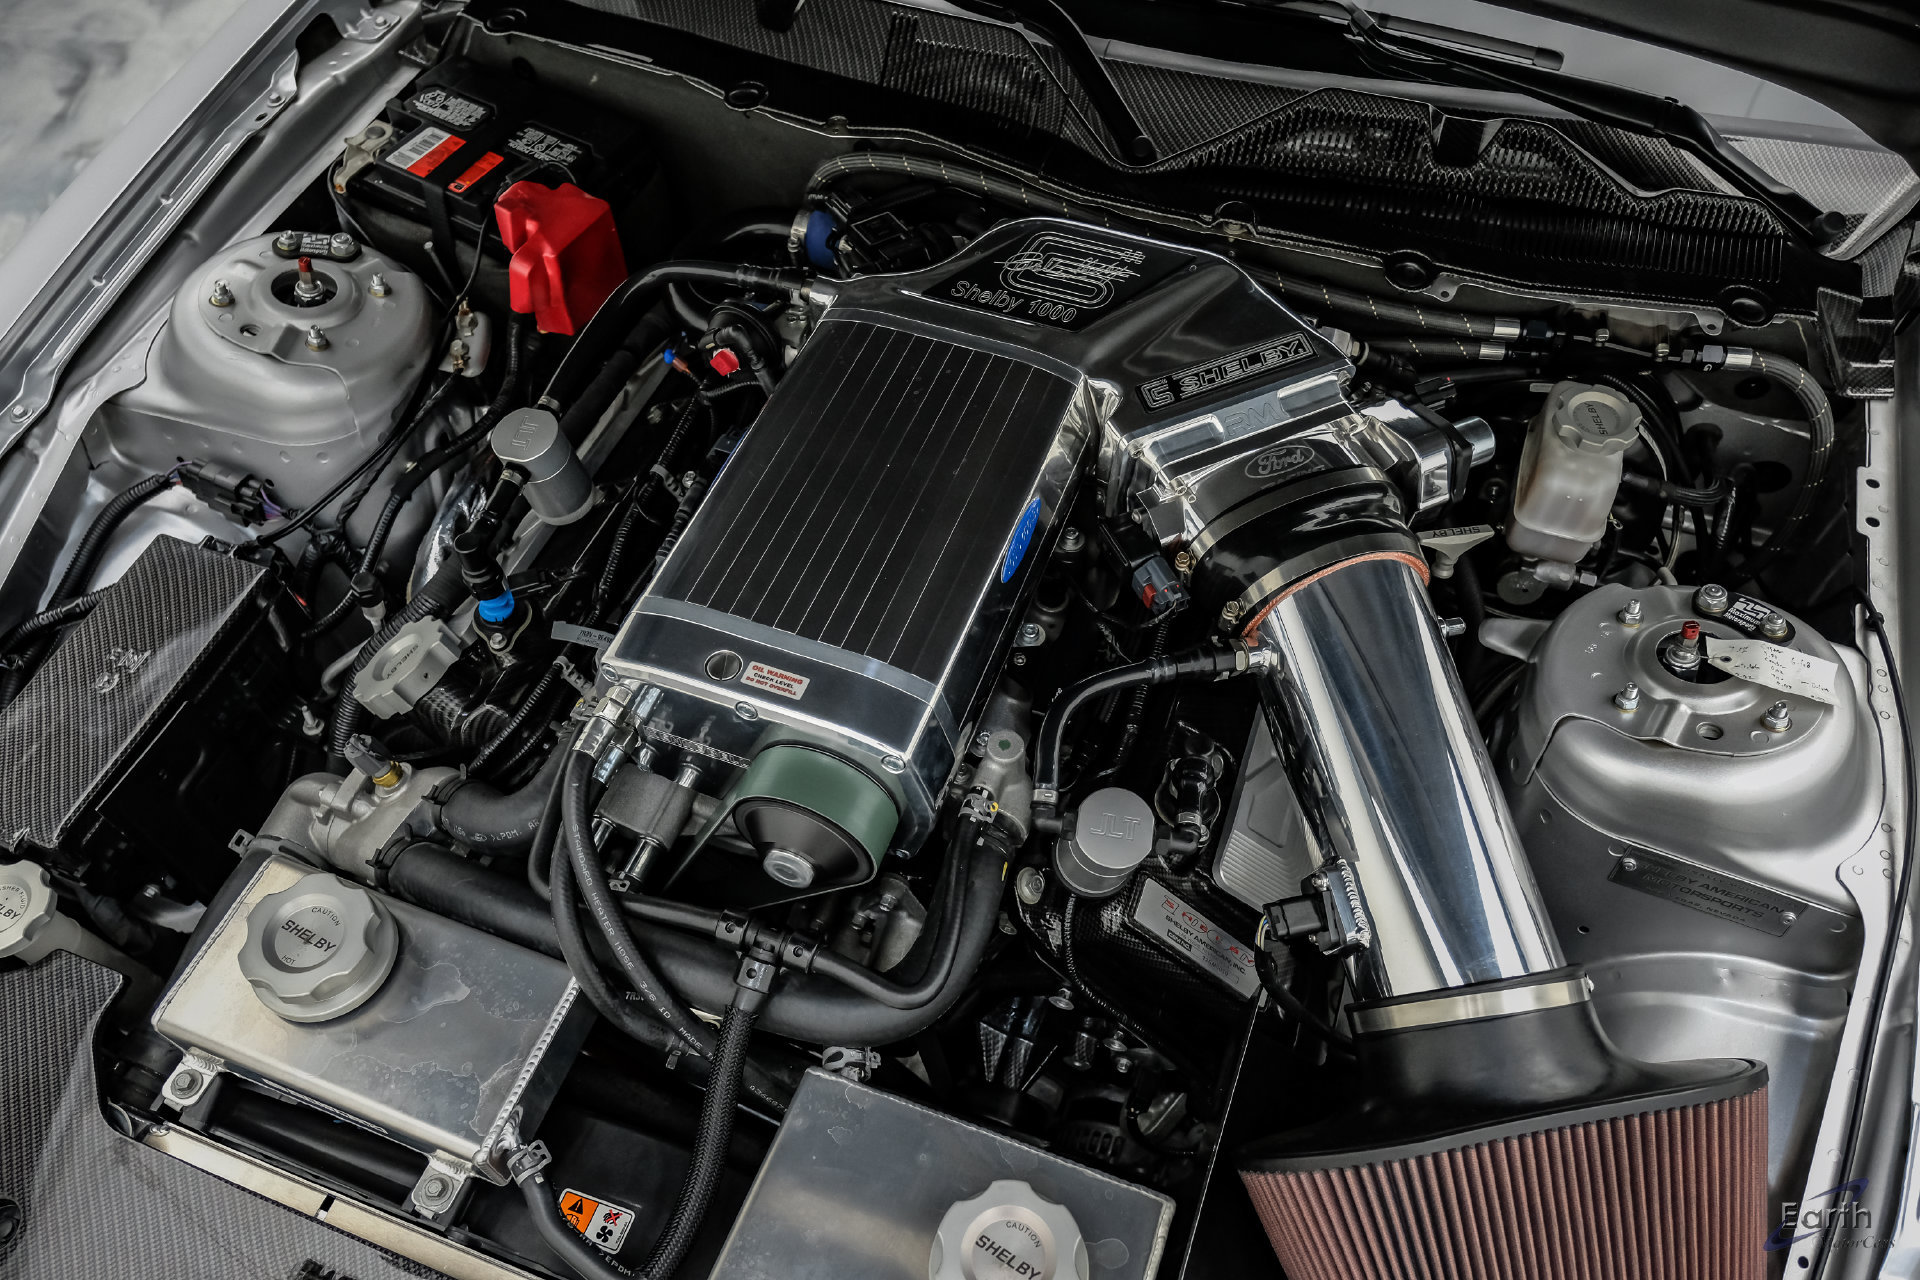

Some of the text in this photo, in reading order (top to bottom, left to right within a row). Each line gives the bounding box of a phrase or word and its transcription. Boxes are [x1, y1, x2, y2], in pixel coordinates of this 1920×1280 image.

[951, 280, 1077, 322] Shelby 1000
[511, 415, 539, 451] JLT
[1584, 402, 1608, 435] SHELBY
[1258, 448, 1304, 475] Ford
[1432, 526, 1480, 538] SHELBY
[1723, 612, 1756, 632] Motorsports
[1727, 607, 1760, 626] Maximum
[387, 644, 418, 680] SHELBY
[752, 664, 803, 685] OIL WARNING
[753, 672, 794, 689] CHECK LEVEL
[769, 683, 797, 696] OVERFILL
[1090, 812, 1141, 841] JLT
[1643, 873, 1764, 918] MOTORSPORTS
[1699, 882, 1785, 914] AMERICAN
[311, 907, 341, 927] CAUTION
[281, 919, 337, 952] SHELBY
[572, 823, 593, 886] STANDARD
[591, 892, 615, 936] HEATER
[614, 941, 635, 970] HOSE
[658, 1006, 672, 1020] ID
[678, 1026, 704, 1050] MADE
[1165, 915, 1194, 937] SHELBY
[1194, 935, 1232, 966] AMERICAN,
[1233, 963, 1247, 975] INC.
[281, 954, 297, 966] HOT
[1005, 1221, 1041, 1248] CAUTION
[975, 1234, 1042, 1280] SHELBY
